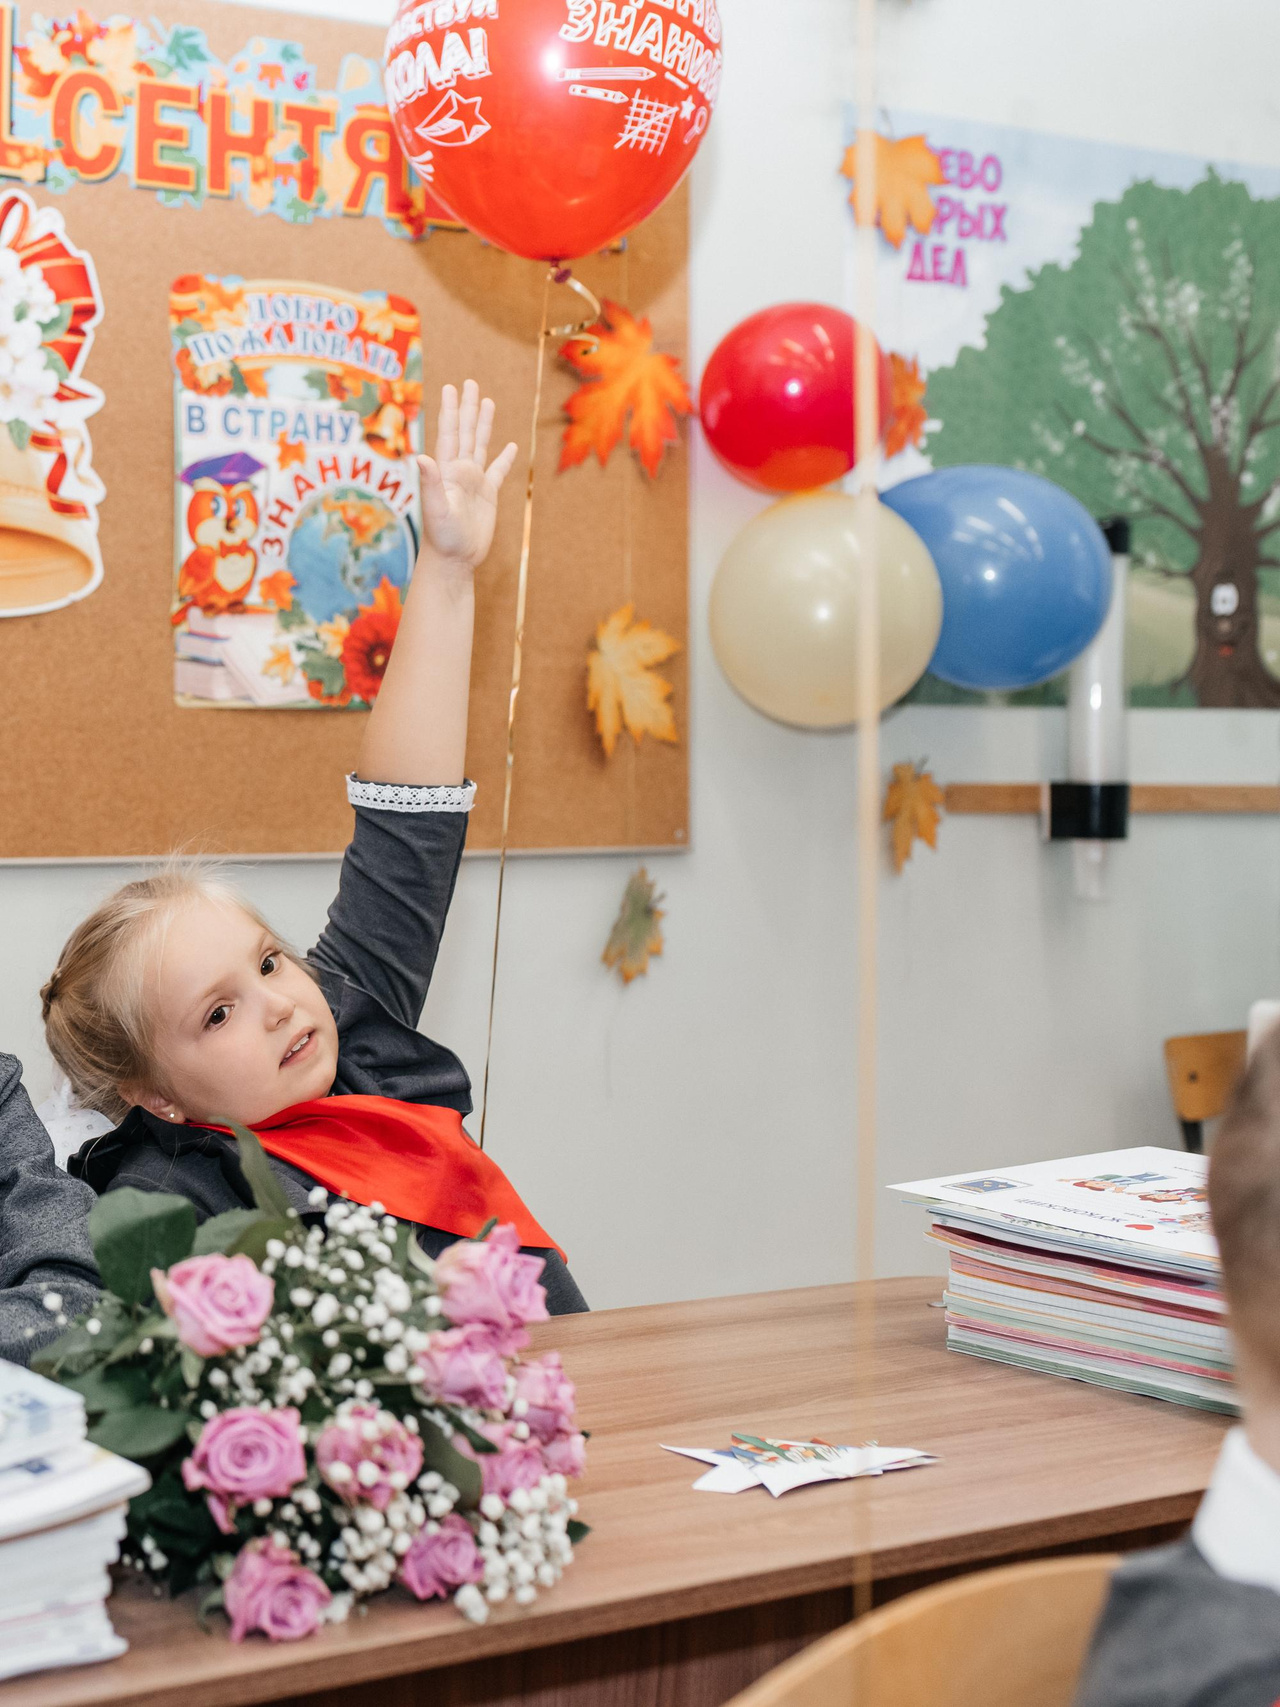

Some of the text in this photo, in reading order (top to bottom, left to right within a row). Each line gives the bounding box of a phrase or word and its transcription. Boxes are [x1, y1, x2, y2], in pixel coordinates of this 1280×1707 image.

[50, 67, 468, 230] СЕНТЯ
[936, 147, 1004, 194] ЕВО
[934, 196, 1008, 243] РЫХ
[906, 240, 968, 288] ДЕЛ
[245, 294, 358, 333] ДОБРО
[190, 326, 403, 379] ПОЖАЛОВАТЬ
[186, 403, 356, 444] В СТРАНУ
